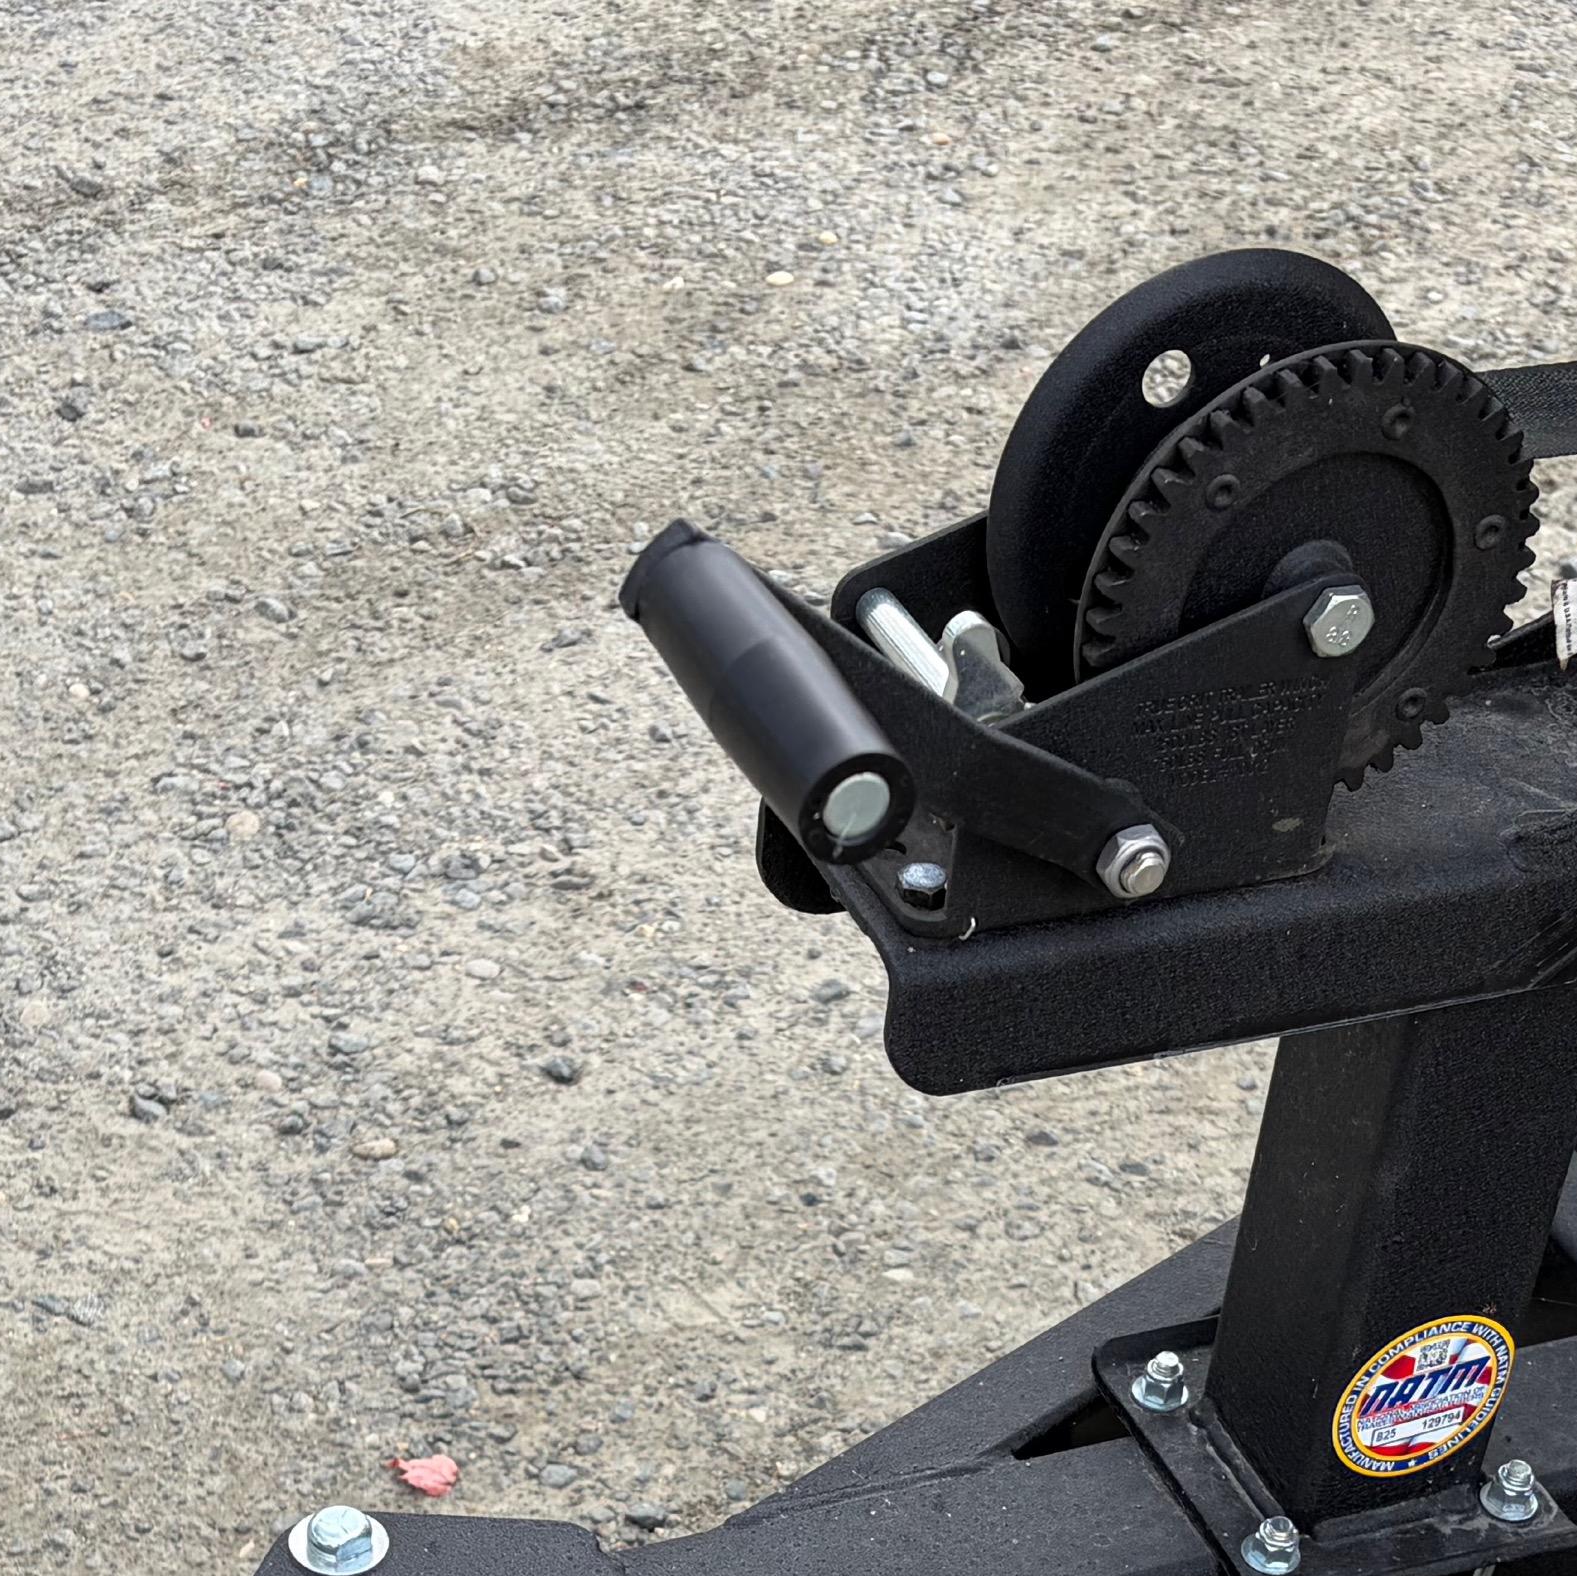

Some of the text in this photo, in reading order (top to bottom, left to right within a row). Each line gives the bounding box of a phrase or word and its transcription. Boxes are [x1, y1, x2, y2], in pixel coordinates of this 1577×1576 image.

[1339, 1395, 1395, 1471] MANUFACTURED
[1369, 1322, 1470, 1373] COMPLIANCE
[1473, 1323, 1504, 1350] WITH
[1376, 1412, 1461, 1442] B25 129794
